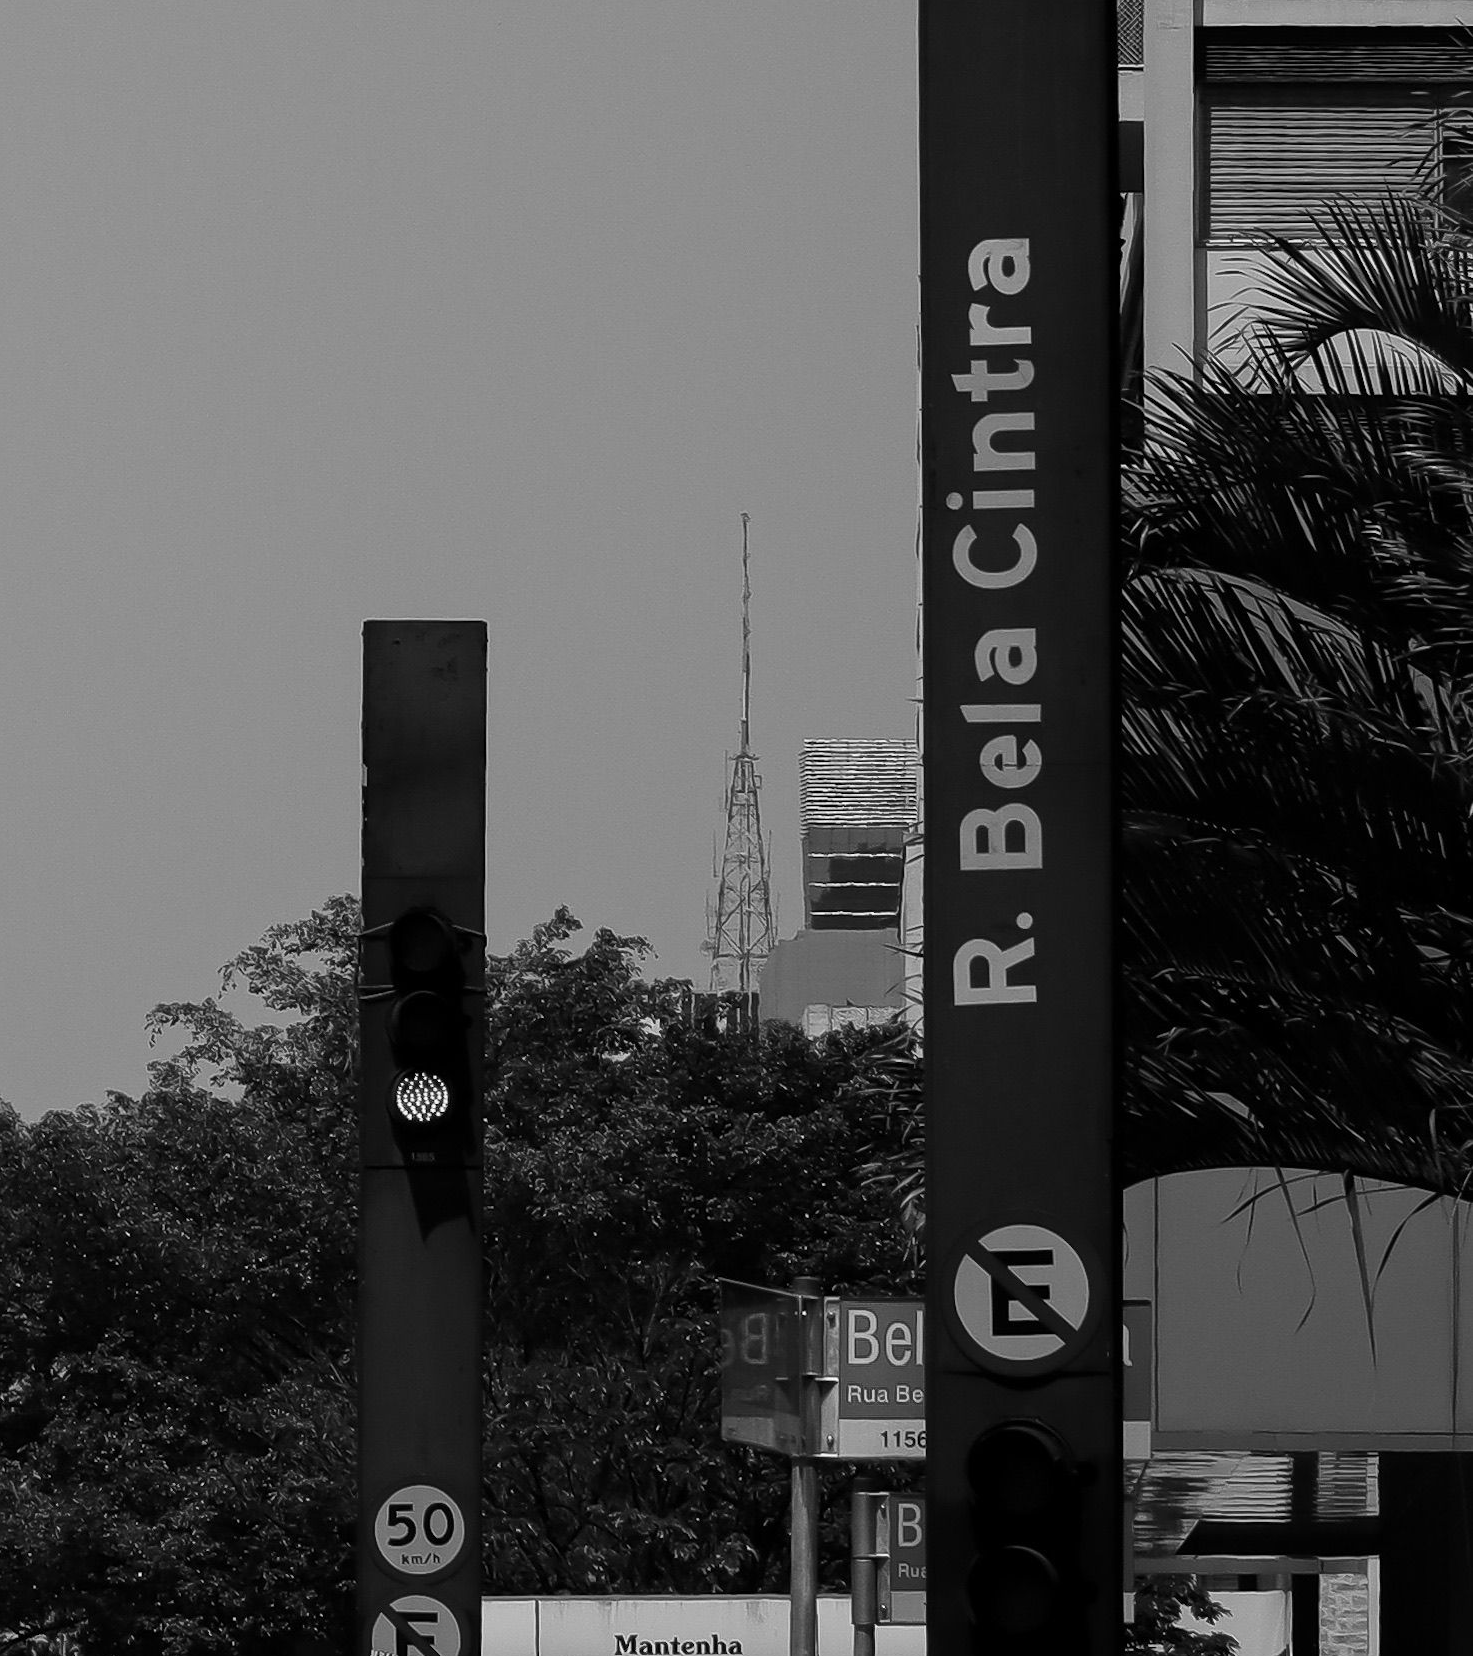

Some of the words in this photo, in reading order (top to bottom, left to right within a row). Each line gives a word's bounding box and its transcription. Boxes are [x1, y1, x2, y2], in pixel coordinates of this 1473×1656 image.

[944, 235, 1039, 590] Cintra
[960, 626, 1045, 874] Bela
[954, 909, 1039, 1008] R.
[848, 1386, 889, 1404] Rua
[388, 1502, 455, 1547] 50
[614, 1635, 743, 1656] Mantenha
